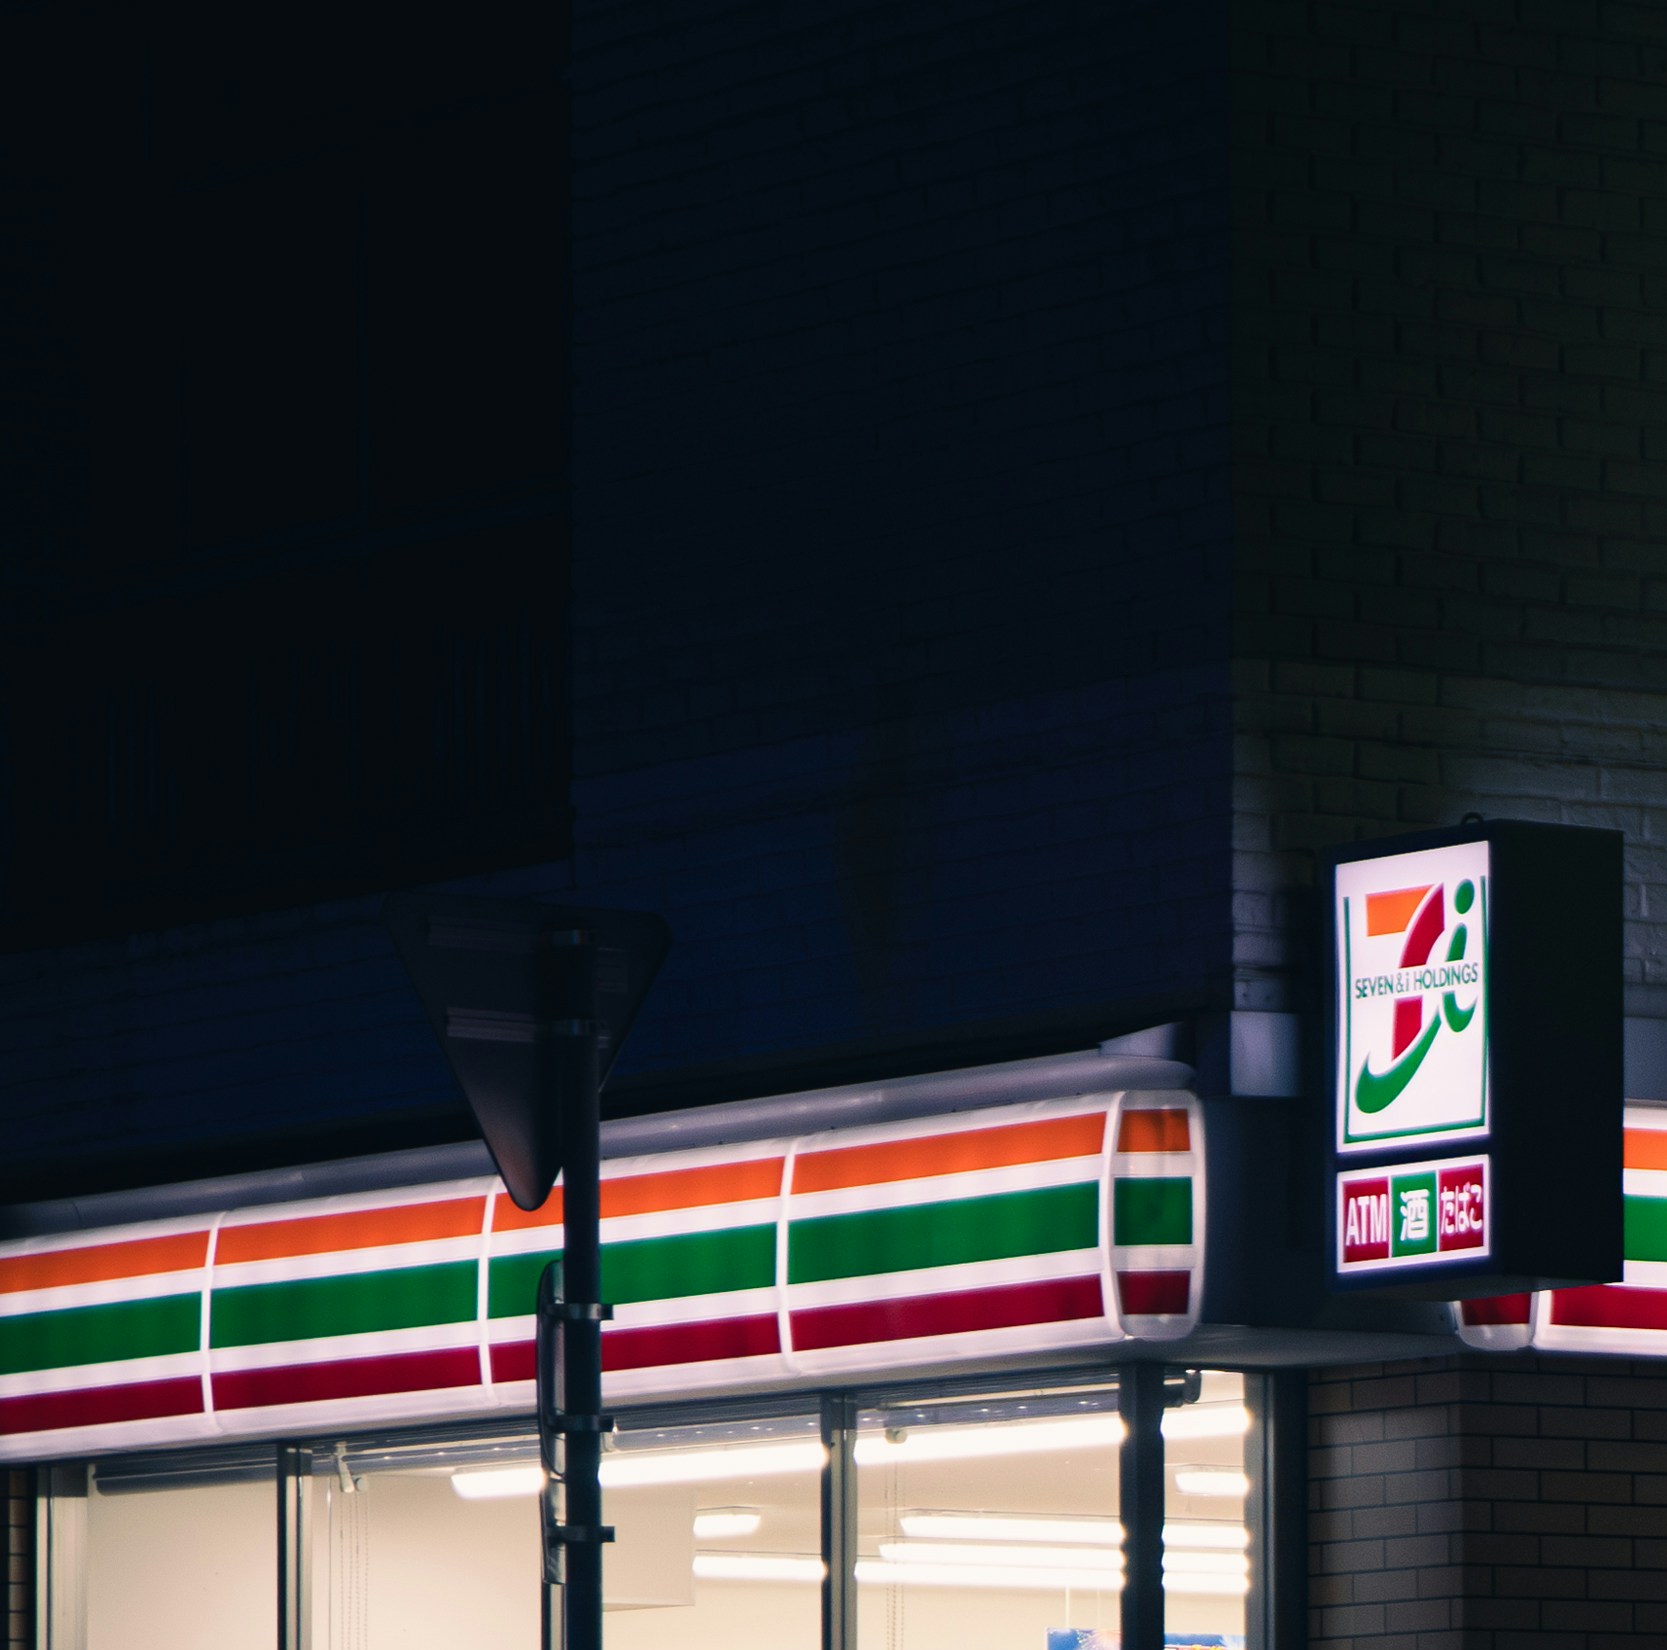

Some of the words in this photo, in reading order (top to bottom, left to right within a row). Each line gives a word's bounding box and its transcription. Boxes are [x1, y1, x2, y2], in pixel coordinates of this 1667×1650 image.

[1355, 972, 1411, 999] SEVEN&i
[1414, 963, 1478, 991] HOLDINGS
[1345, 1194, 1388, 1245] ATM
[1401, 1189, 1429, 1241] 酒
[1440, 1183, 1483, 1236] たばこ
